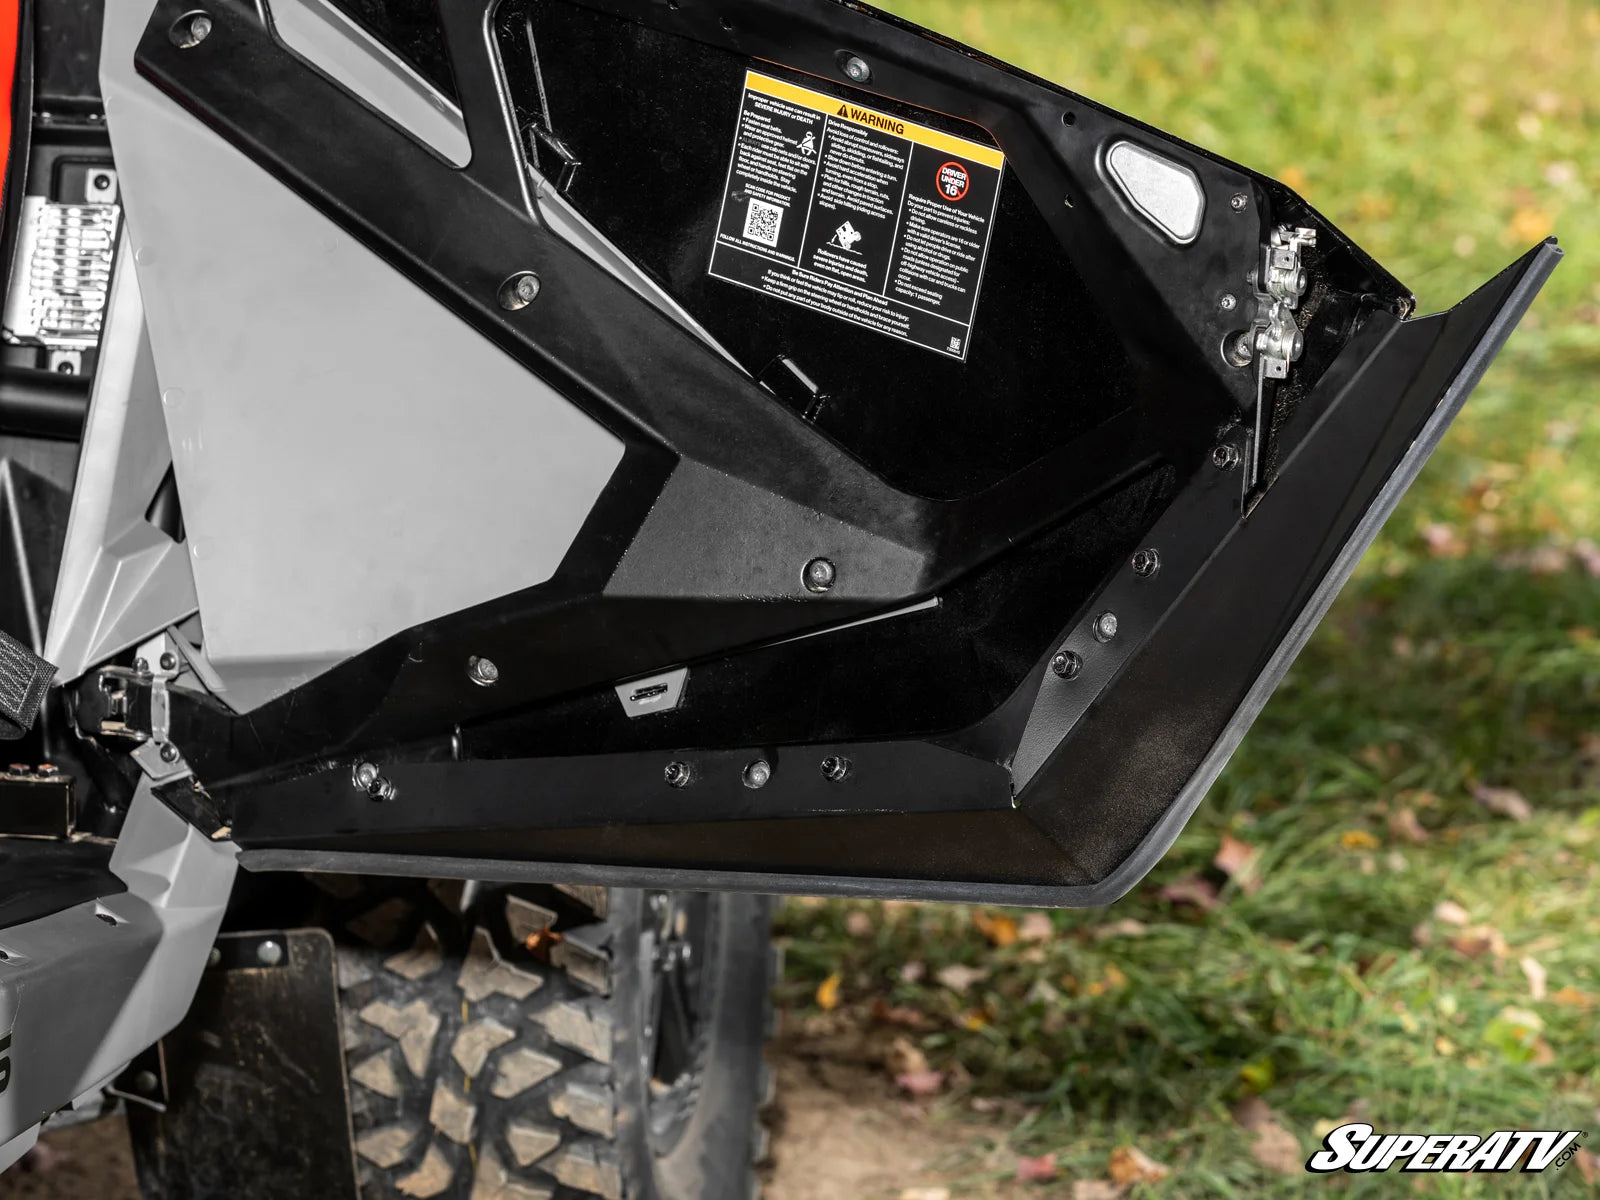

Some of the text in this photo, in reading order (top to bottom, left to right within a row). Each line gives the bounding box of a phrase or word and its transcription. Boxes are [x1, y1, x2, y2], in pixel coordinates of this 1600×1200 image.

[748, 93, 769, 103] Improper
[770, 101, 786, 109] vehicle
[750, 112, 771, 123] Prepared
[755, 102, 774, 112] SEVERE
[773, 108, 791, 117] INJURY
[796, 115, 813, 125] DEATH
[851, 108, 904, 134] WARNING
[828, 119, 868, 137] Drive Responsibly
[941, 175, 965, 188] UNDER
[942, 167, 967, 180] DRIVER
[945, 184, 958, 196] 16
[909, 194, 926, 204] Require
[927, 200, 942, 209] Proper
[968, 213, 985, 223] Vehicle
[813, 255, 828, 263] severe
[828, 259, 845, 268] injuries
[817, 248, 839, 260] Rollovers
[850, 260, 867, 269] caused
[809, 275, 824, 284] Riders
[824, 280, 833, 288] Pay
[833, 284, 854, 294] Attention
[863, 293, 873, 301] Plan
[873, 297, 888, 306] Ahead
